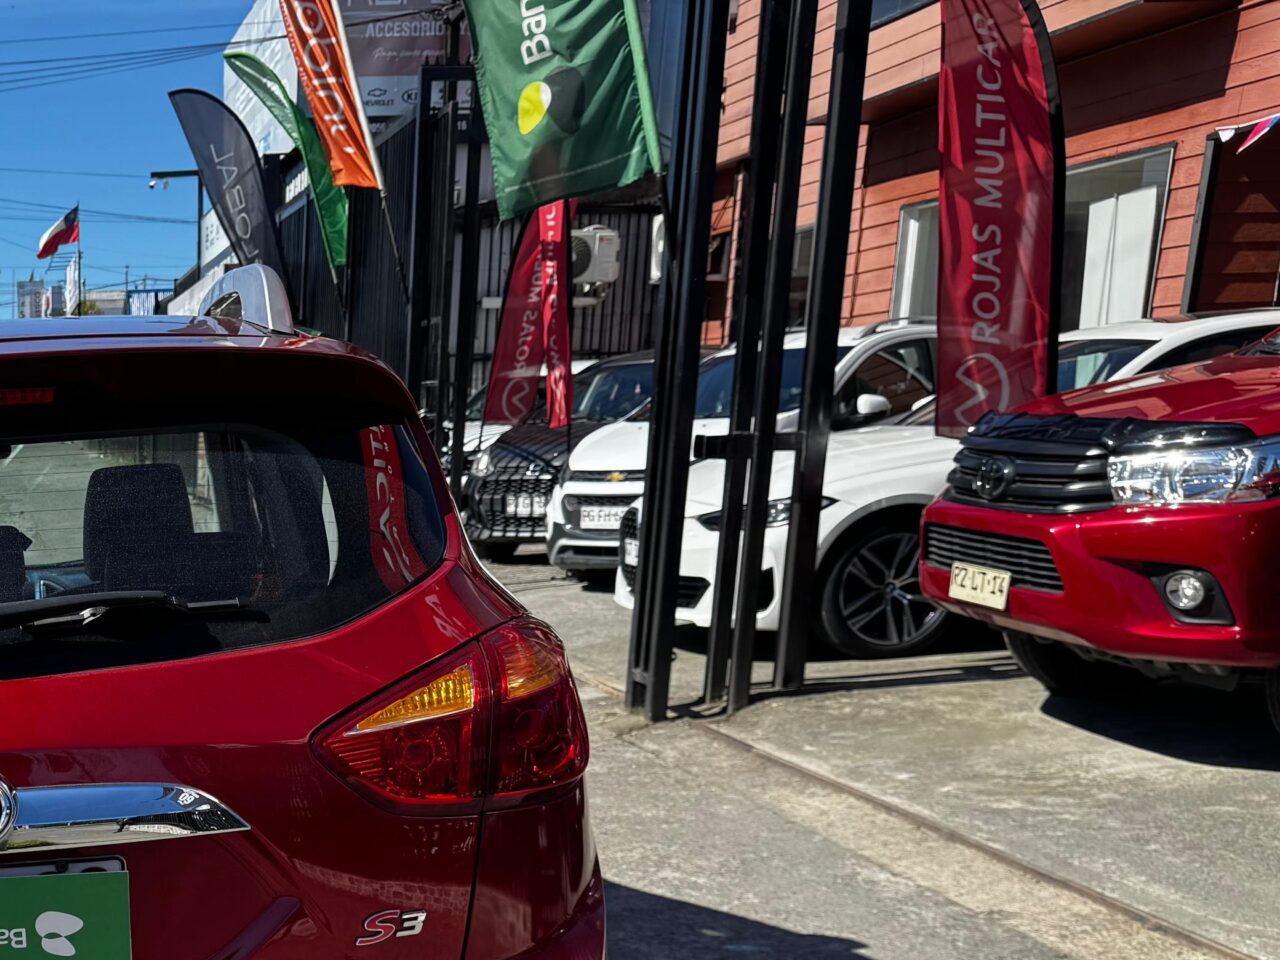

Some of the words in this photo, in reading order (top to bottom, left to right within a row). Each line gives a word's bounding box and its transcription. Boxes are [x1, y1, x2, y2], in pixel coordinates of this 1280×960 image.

[972, 12, 1007, 209] MULTICAR
[971, 223, 1002, 345] ROJAS
[355, 909, 427, 946] S3
